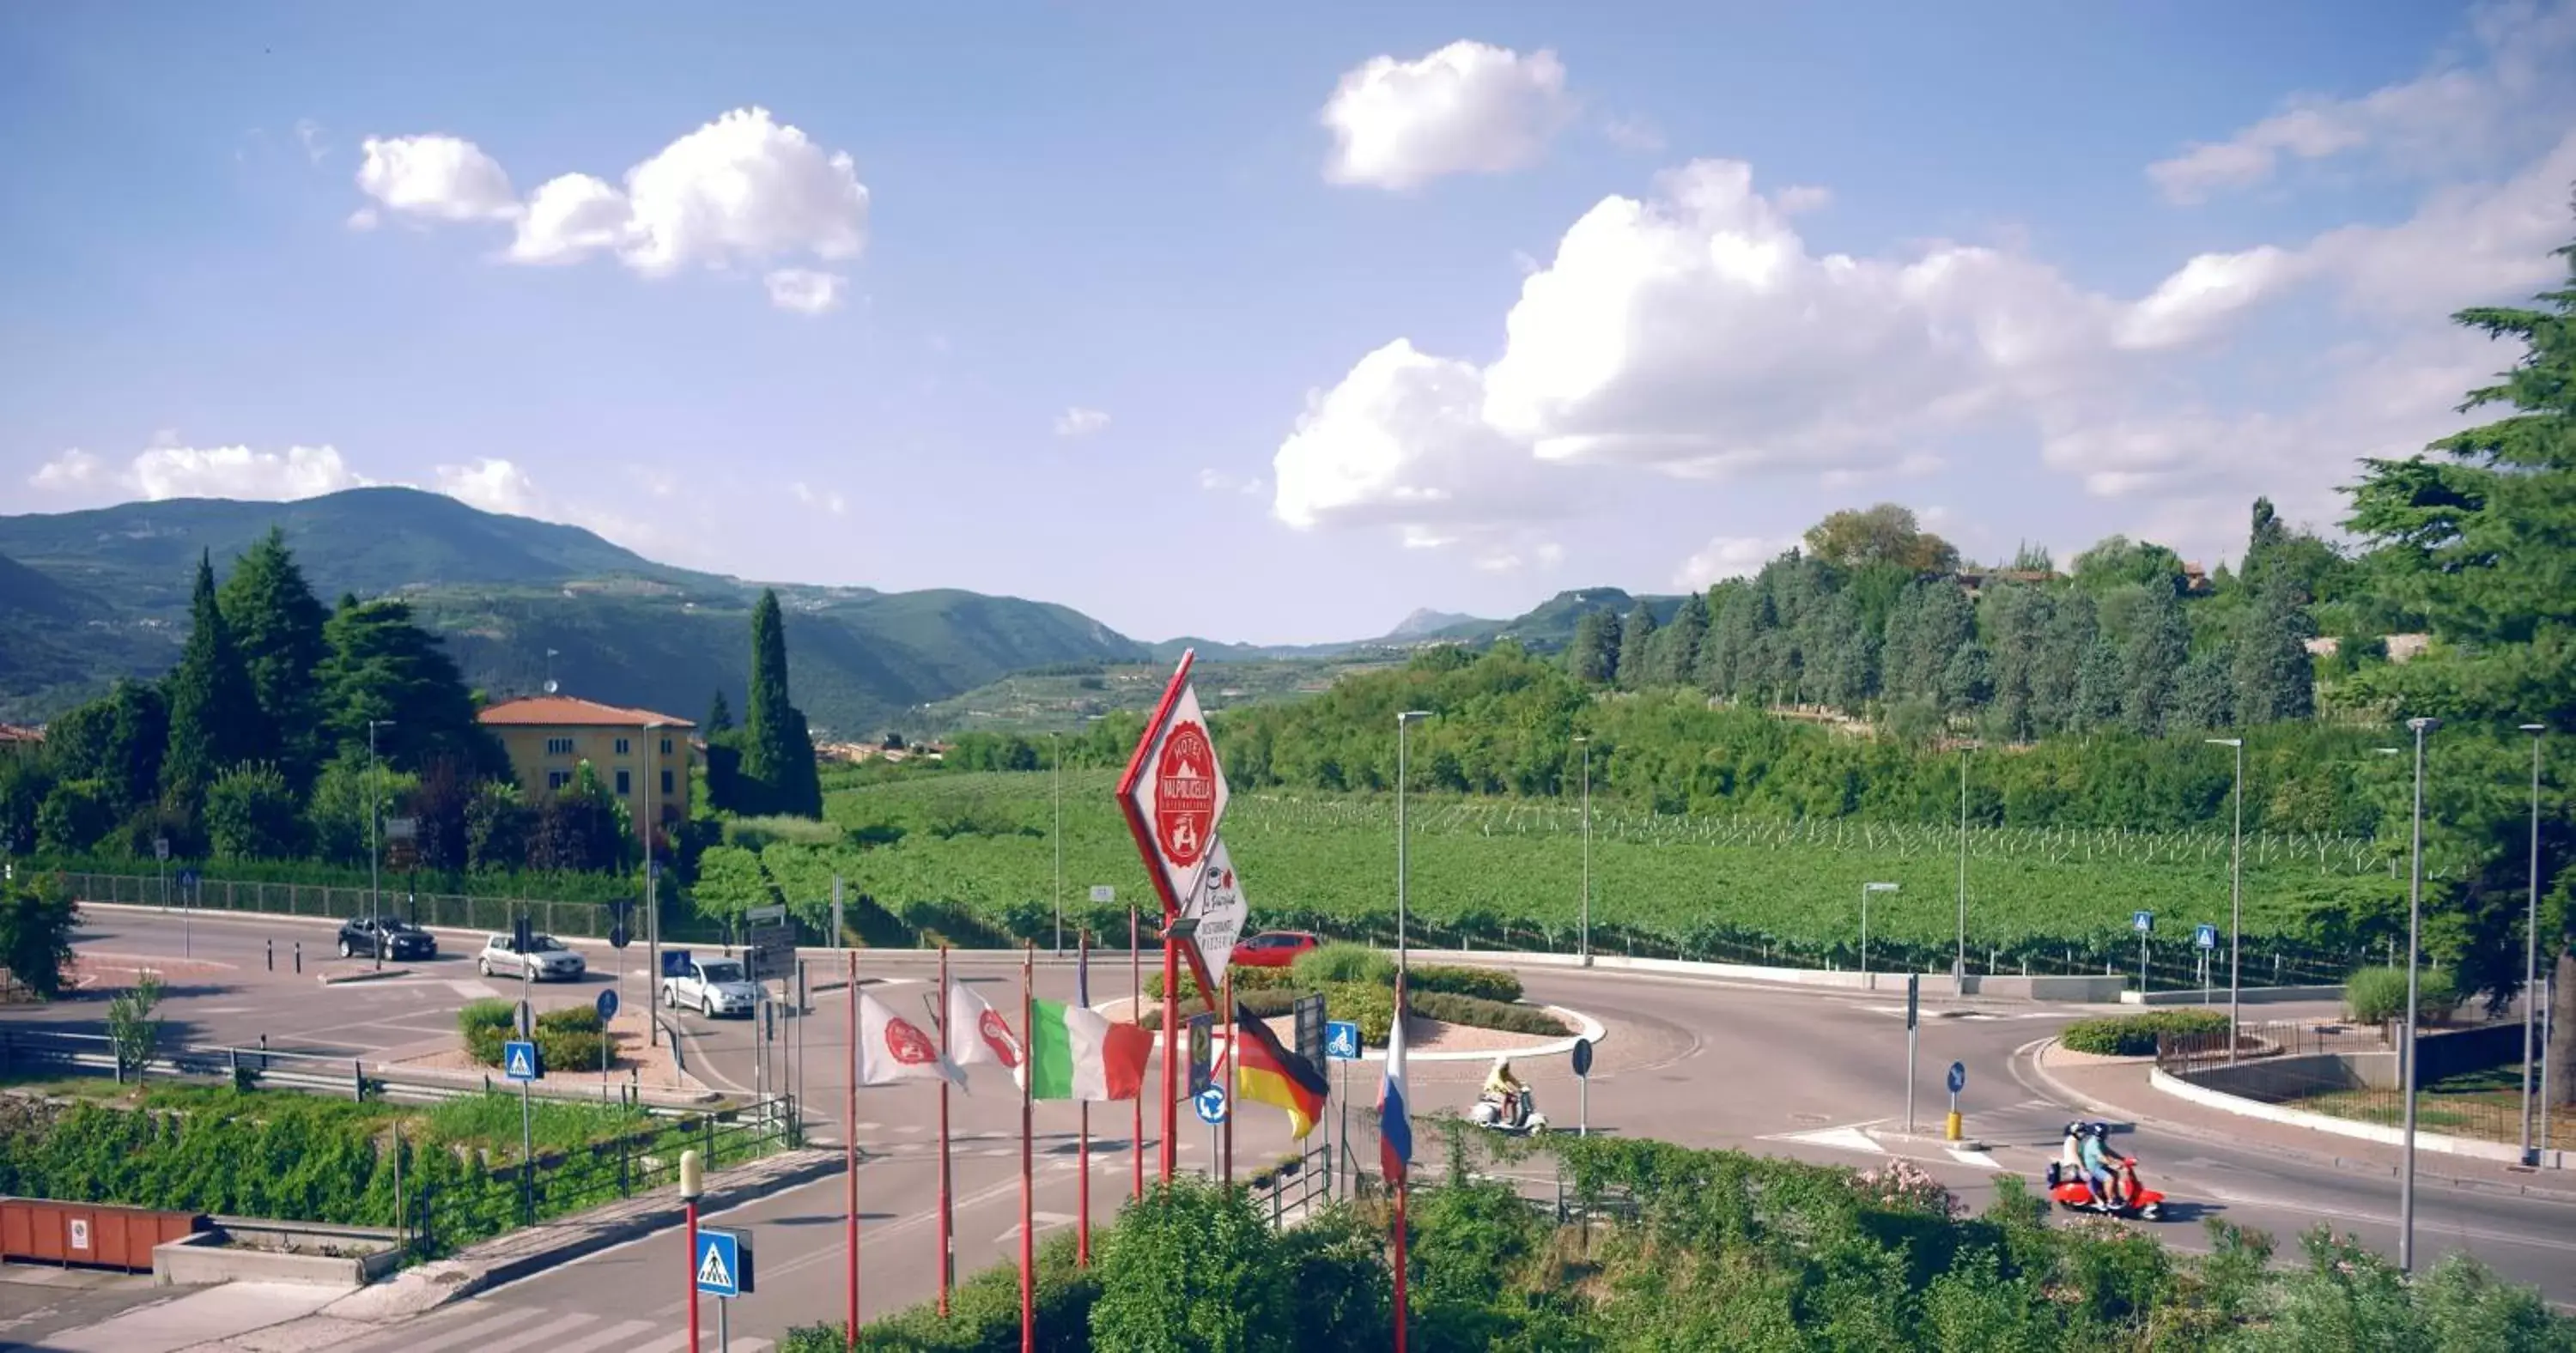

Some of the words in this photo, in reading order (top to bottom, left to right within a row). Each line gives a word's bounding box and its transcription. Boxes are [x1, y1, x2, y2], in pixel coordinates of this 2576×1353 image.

[1175, 738, 1201, 761] HOTEL
[1164, 779, 1210, 798] VALPOLICELLA
[1202, 934, 1235, 951] PIZZERIA
